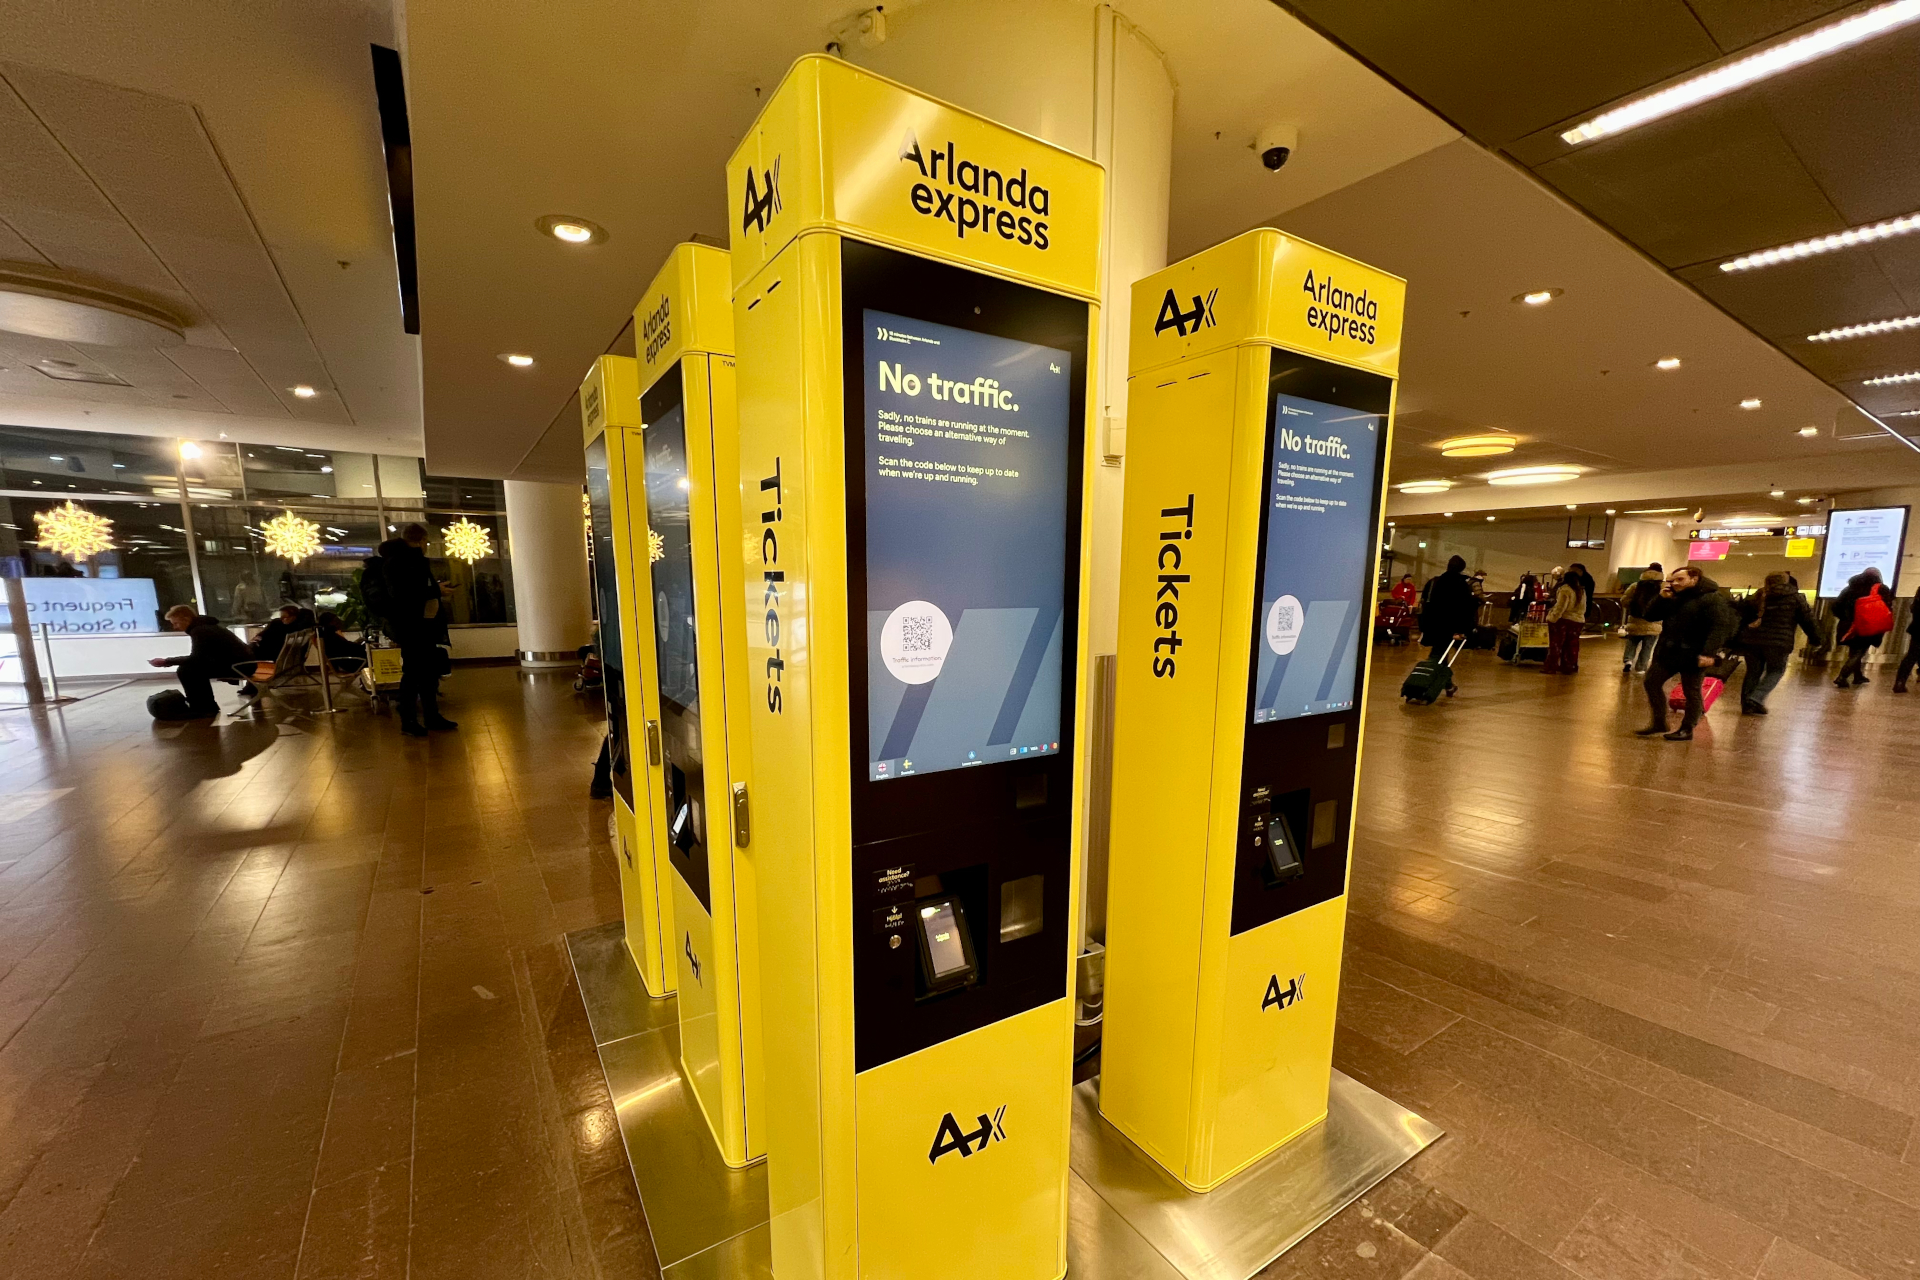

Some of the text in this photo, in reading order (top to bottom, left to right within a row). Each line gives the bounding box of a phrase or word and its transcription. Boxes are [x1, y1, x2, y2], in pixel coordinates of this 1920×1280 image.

[898, 127, 1048, 216] Arlanda
[911, 183, 1049, 250] express
[644, 293, 670, 342] Arlanda
[1303, 269, 1378, 321] Arlanda
[646, 320, 670, 366] express
[1307, 306, 1376, 345] express
[879, 360, 1020, 412] No traffic.
[878, 410, 1030, 438] Sadly, no trains are running at the moment.
[878, 420, 1006, 446] Please choose an alternative way of
[878, 432, 915, 446] traveling.
[1280, 428, 1351, 460] No traffic.
[878, 456, 1020, 478] Scan the code below to keep up to date
[878, 468, 900, 477] when
[924, 473, 934, 482] up
[934, 474, 949, 482] and
[950, 475, 979, 486] running.
[760, 456, 784, 716] Tickets
[1152, 494, 1194, 679] Tickets
